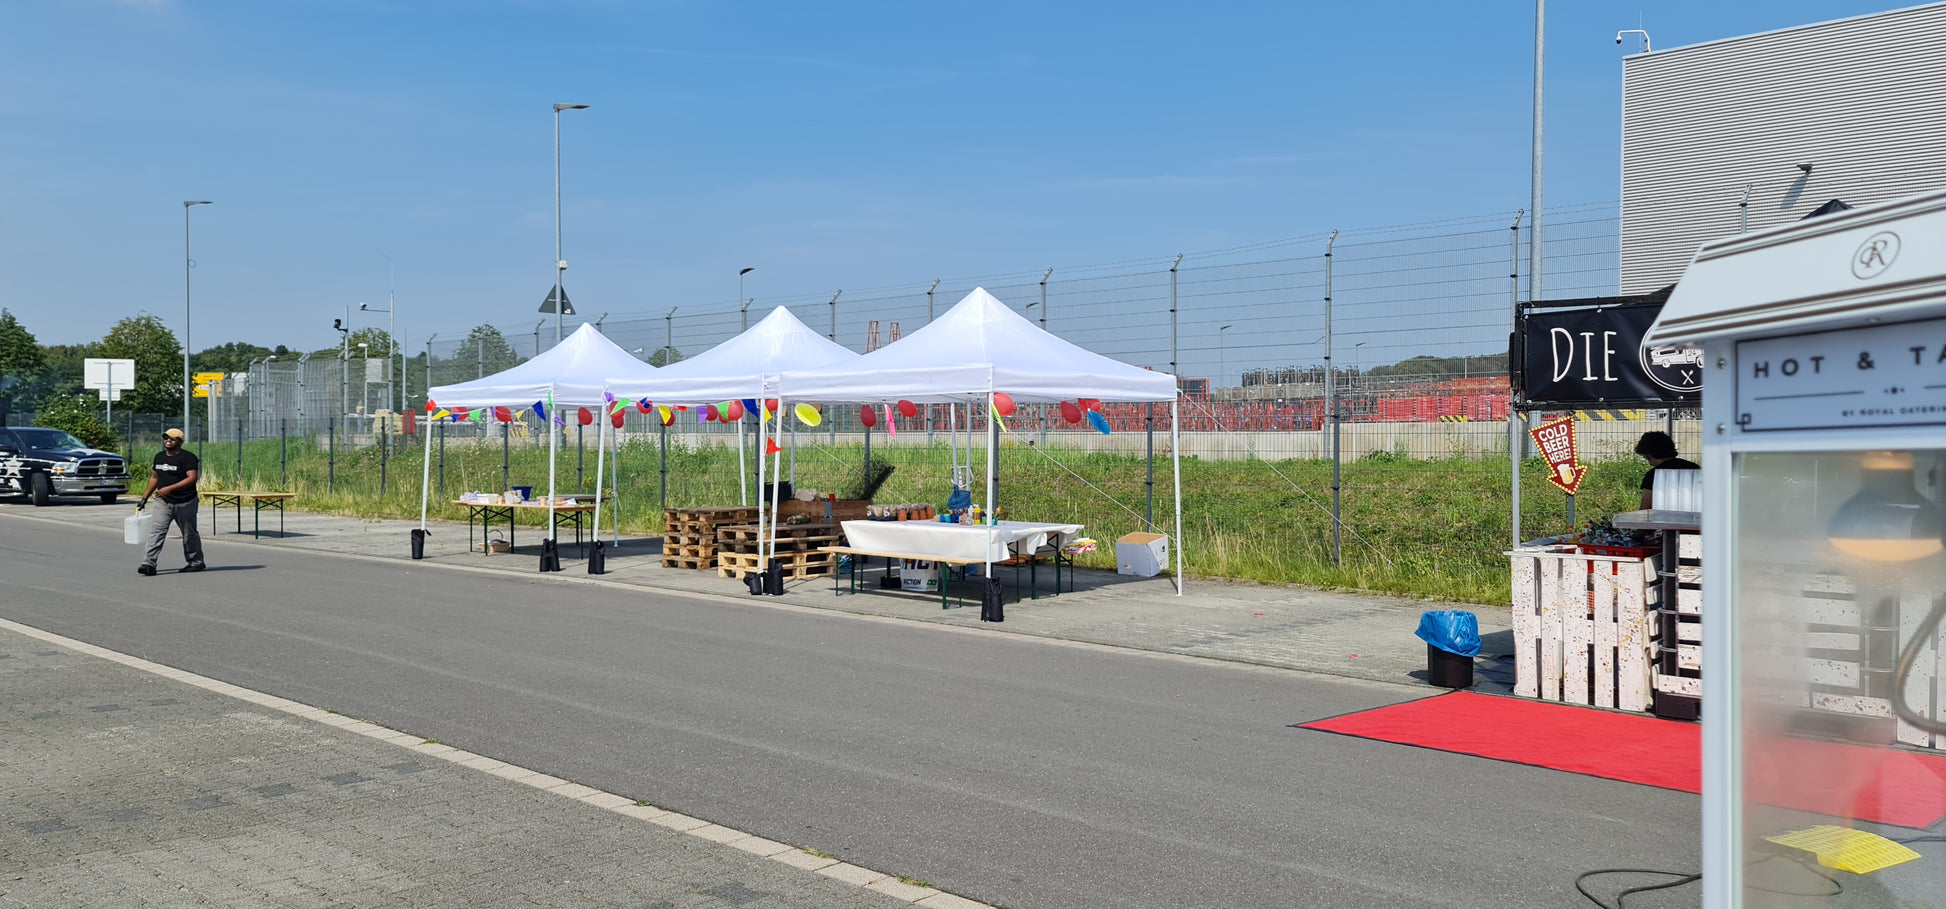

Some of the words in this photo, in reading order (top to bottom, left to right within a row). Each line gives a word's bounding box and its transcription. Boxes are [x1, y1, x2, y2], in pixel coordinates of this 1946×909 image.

[1550, 327, 1619, 383] DIE
[1754, 355, 1825, 379] HOT
[1857, 351, 1875, 370] &
[1860, 408, 1894, 416] ROYAL
[1538, 424, 1568, 442] COLD
[1543, 435, 1570, 454] BEER
[1548, 447, 1572, 464] HERE!
